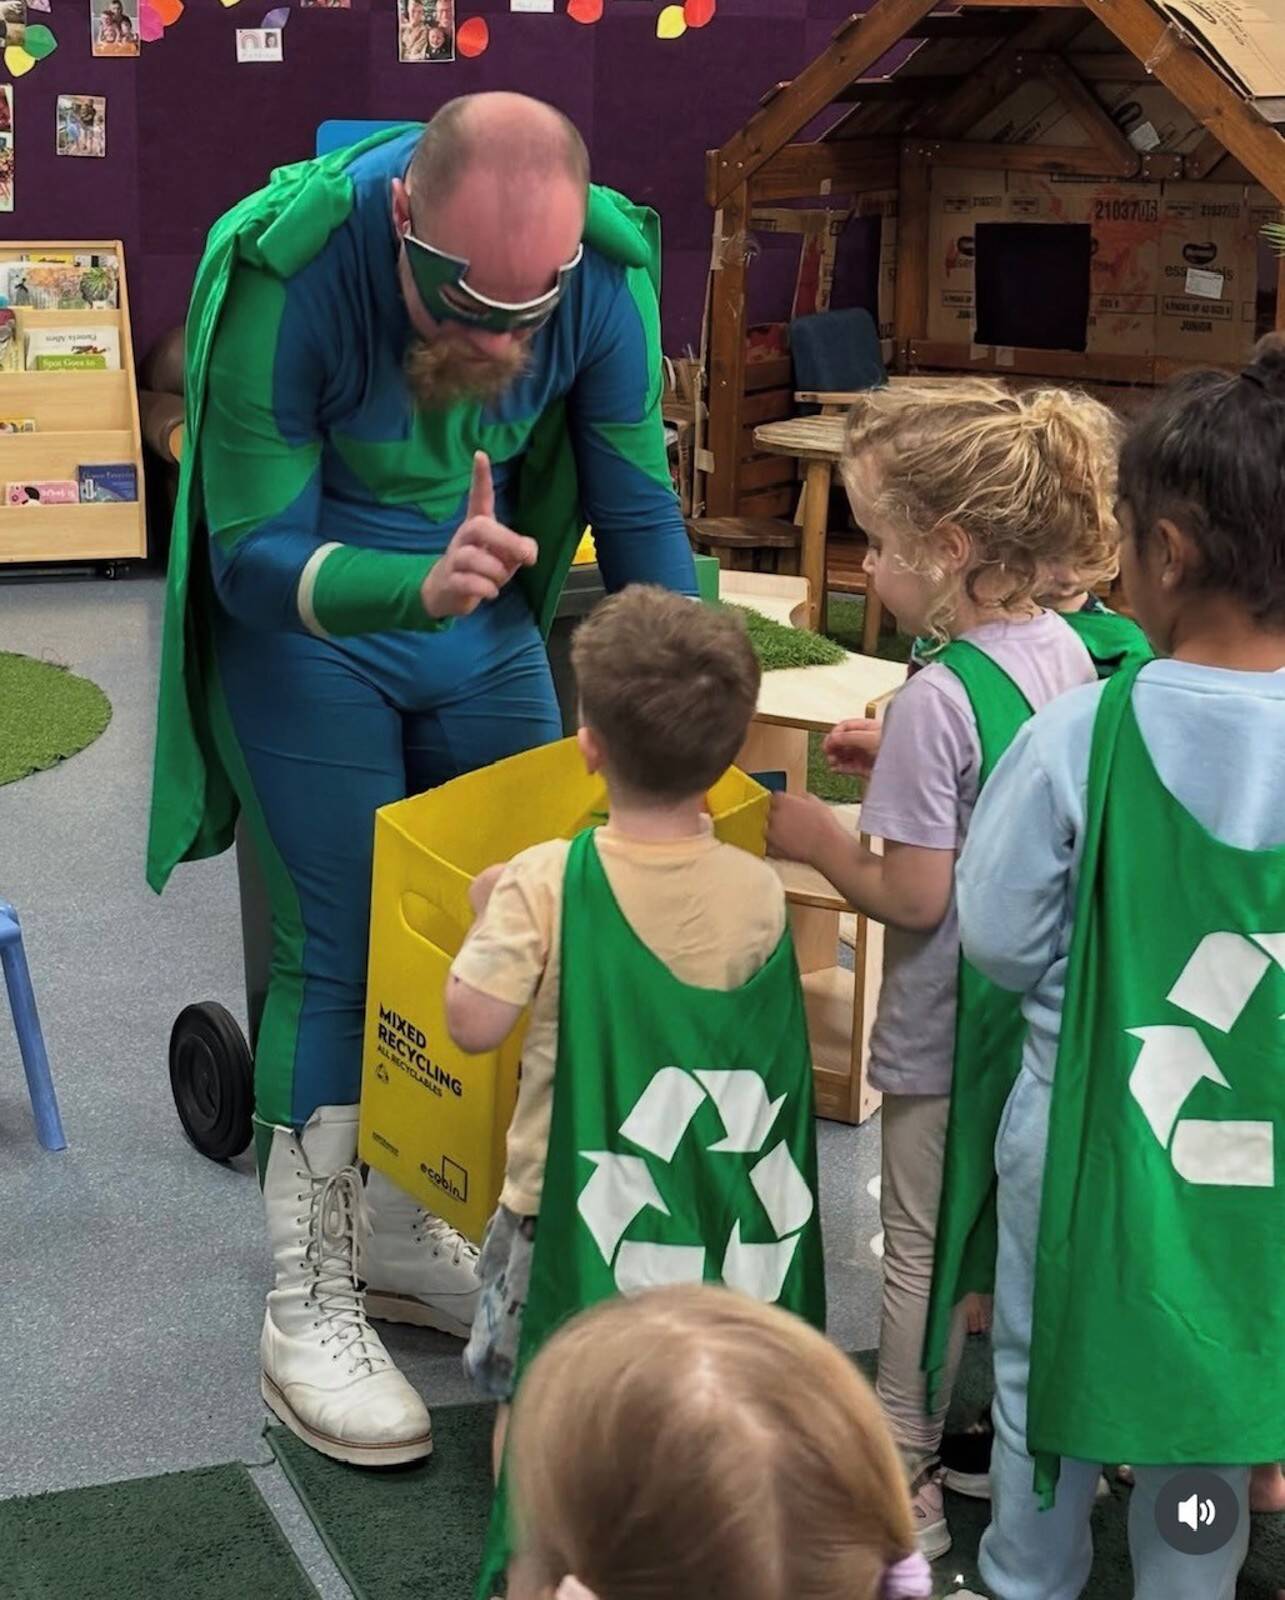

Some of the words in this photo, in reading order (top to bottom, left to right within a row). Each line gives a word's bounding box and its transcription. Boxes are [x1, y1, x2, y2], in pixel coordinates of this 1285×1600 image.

[379, 1002, 427, 1049] MIXED
[377, 1045, 390, 1061] ALL
[391, 1054, 443, 1098] RECYCLABLES
[378, 1023, 463, 1097] RECYCLING
[420, 1160, 463, 1201] ecobin
